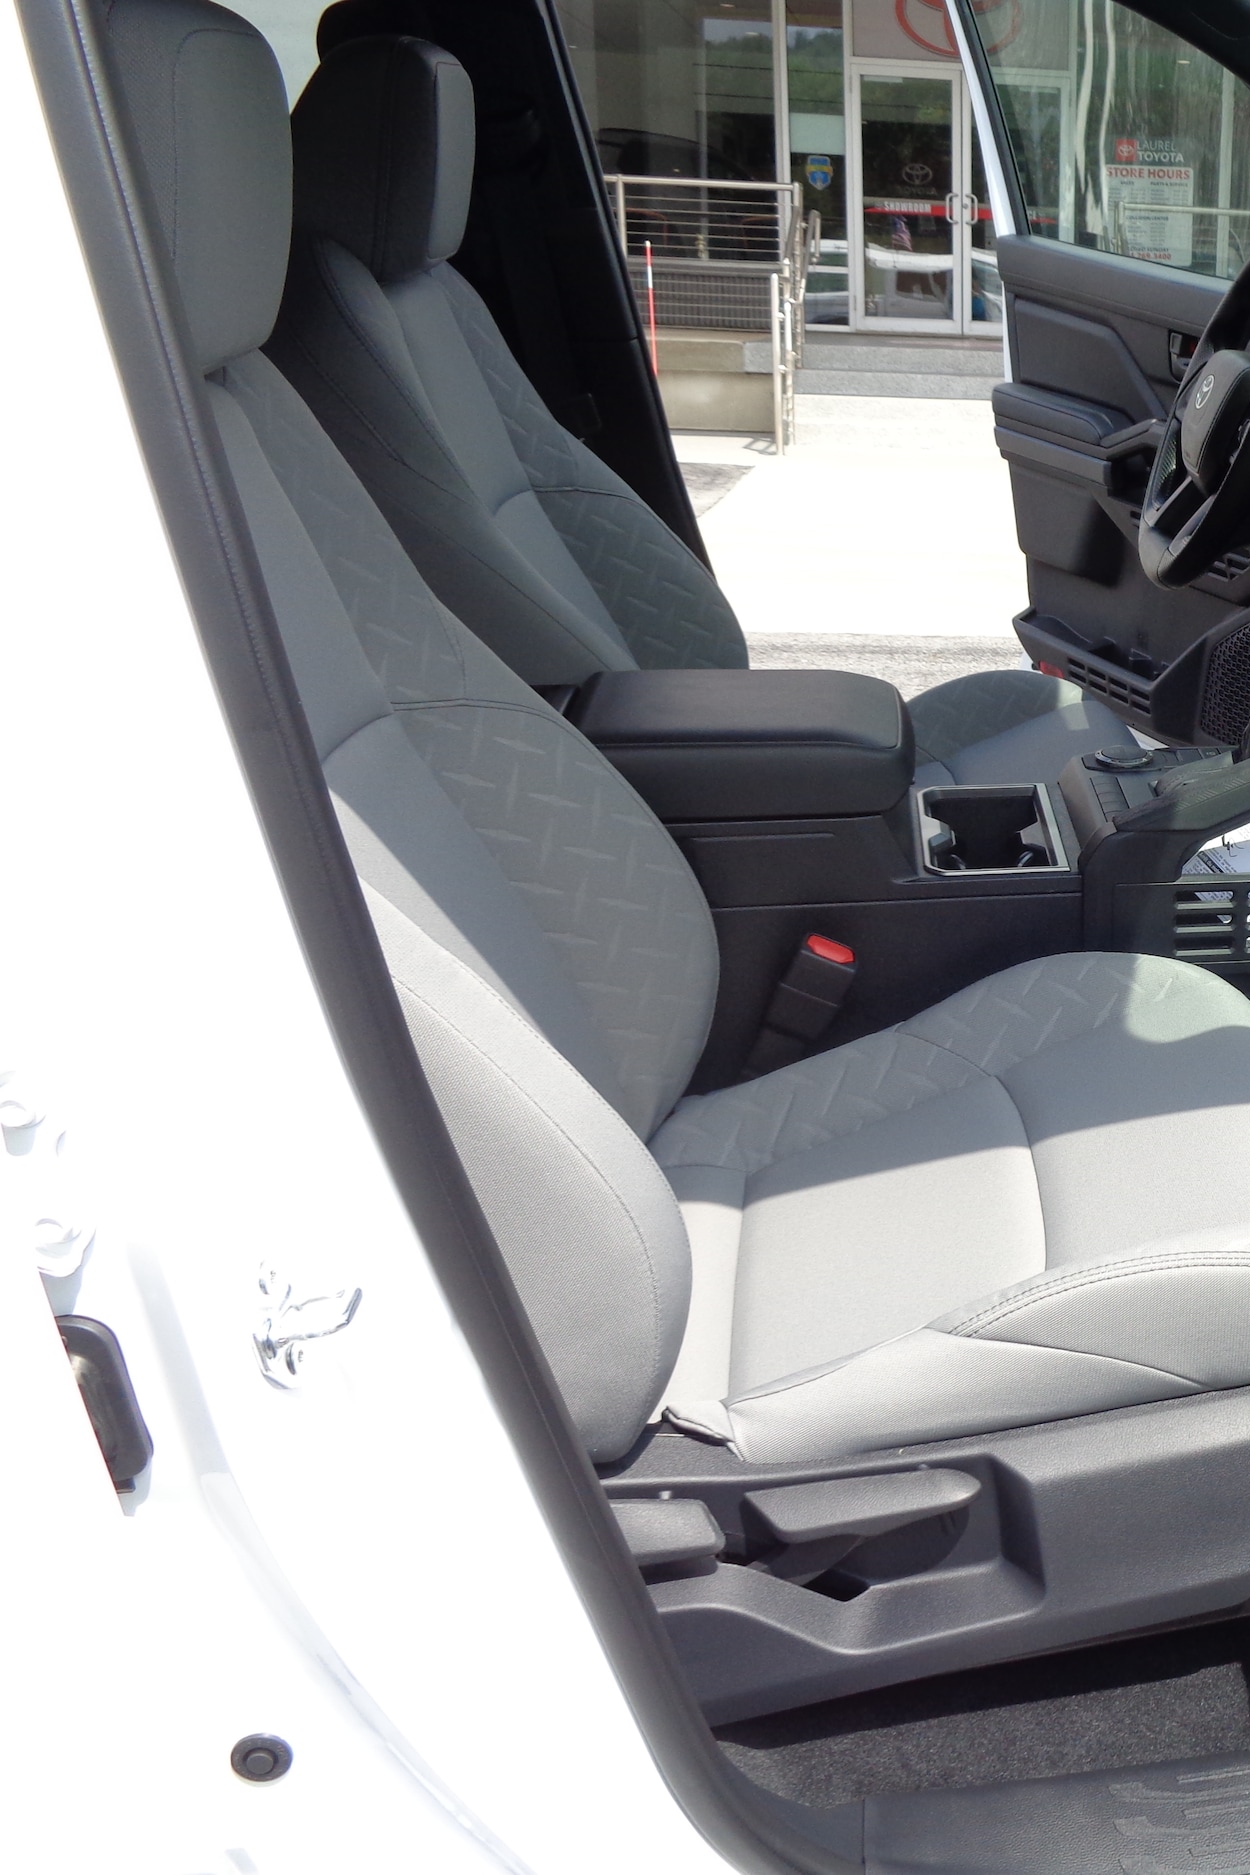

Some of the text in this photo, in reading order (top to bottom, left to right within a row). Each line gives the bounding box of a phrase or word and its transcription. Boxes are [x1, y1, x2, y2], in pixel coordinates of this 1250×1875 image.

[1137, 140, 1176, 152] LAUREL
[1138, 151, 1184, 162] TOYOTA
[1106, 166, 1190, 180] STORE HOURS
[884, 201, 931, 213] SHOWROOM
